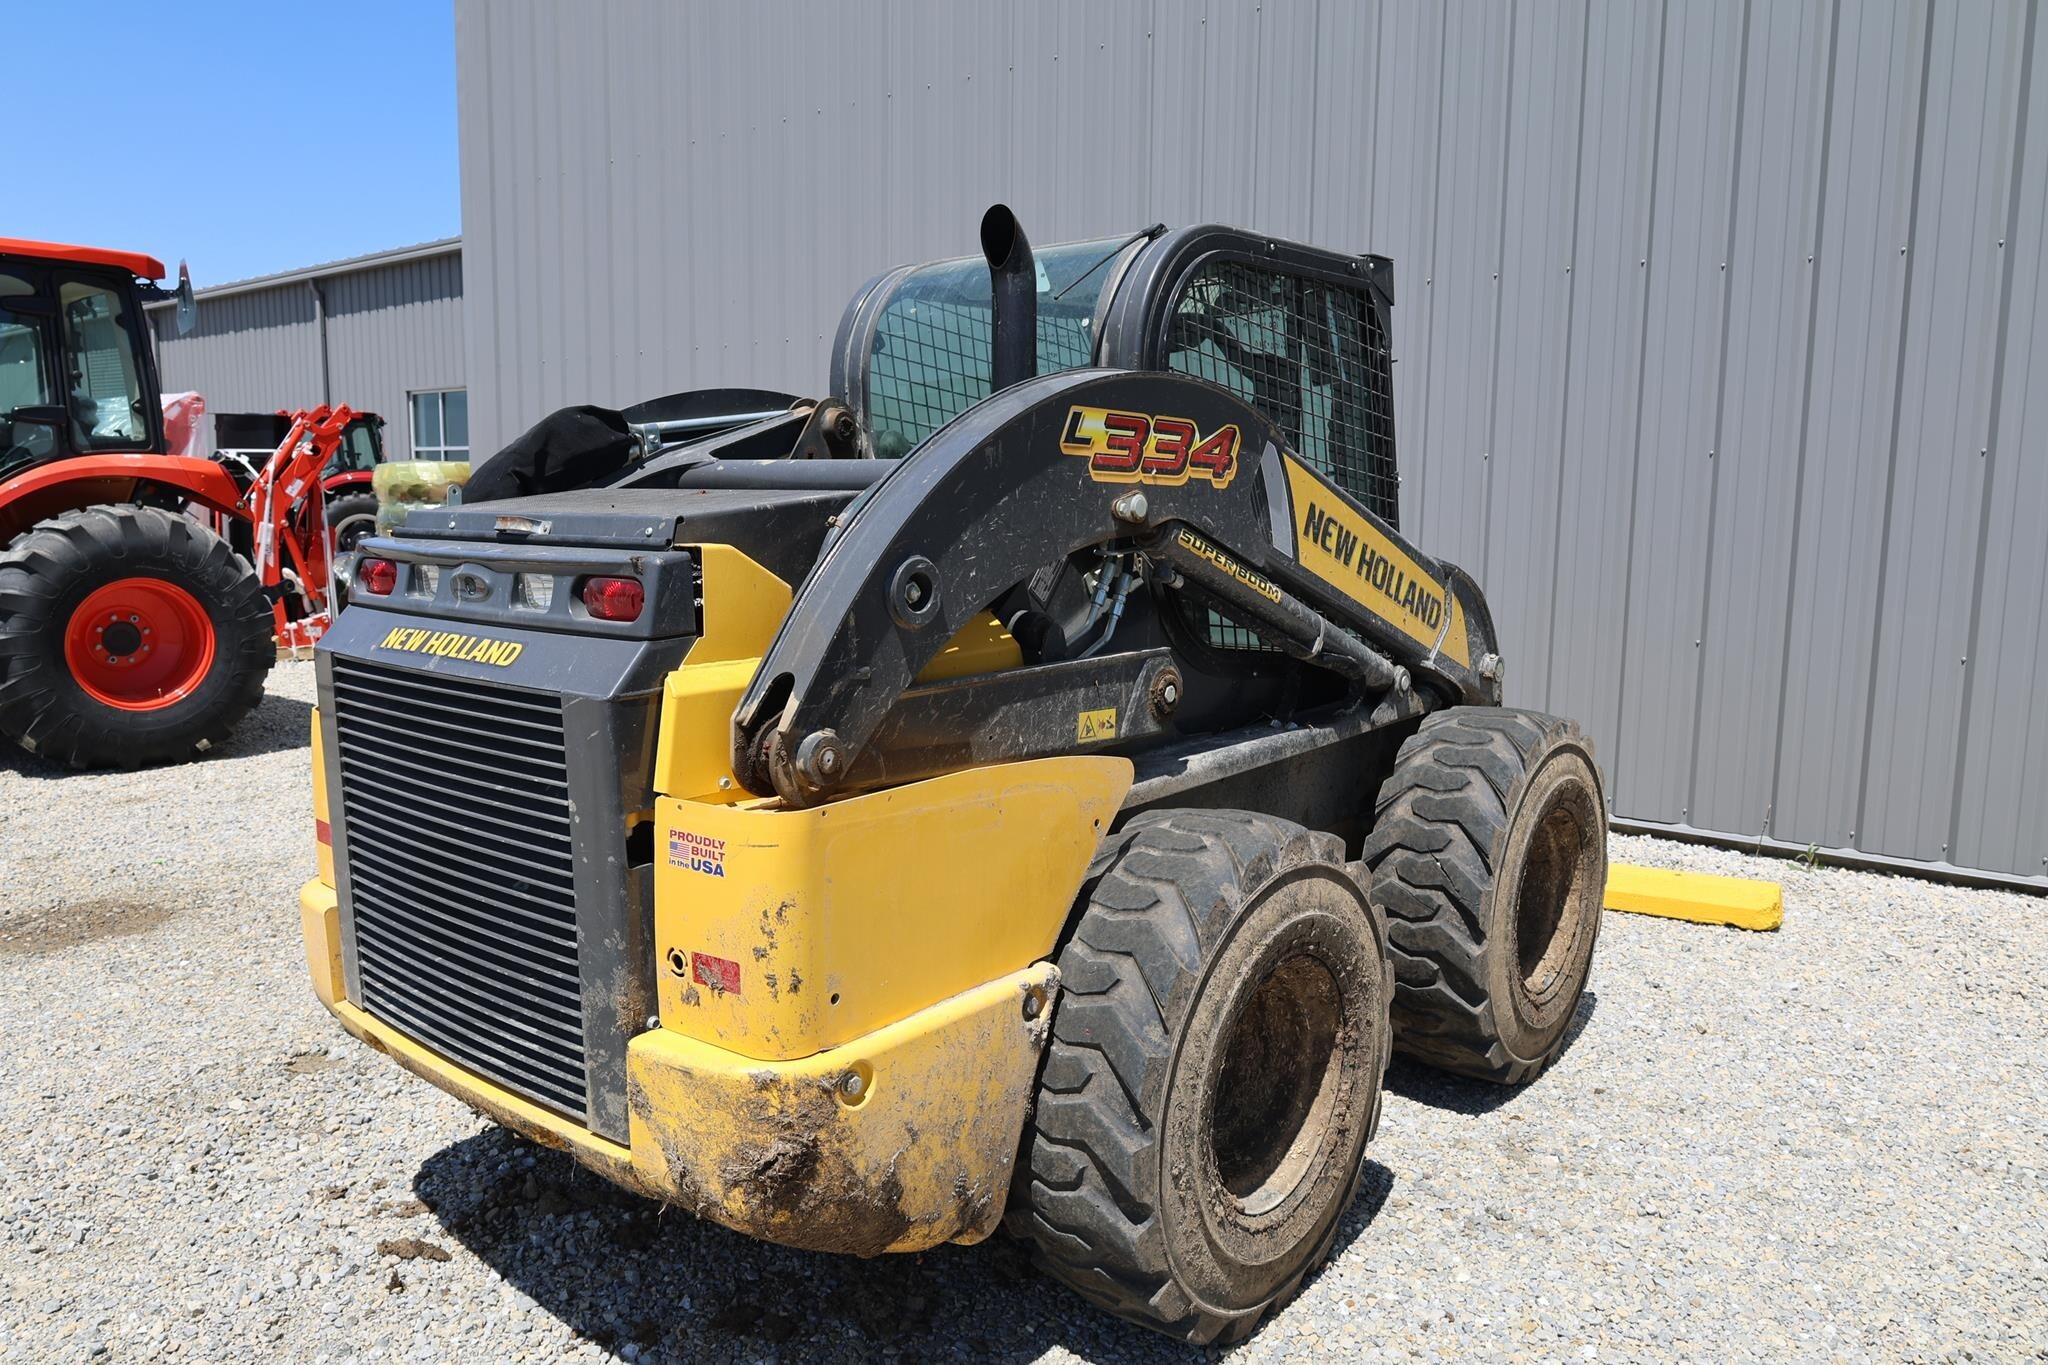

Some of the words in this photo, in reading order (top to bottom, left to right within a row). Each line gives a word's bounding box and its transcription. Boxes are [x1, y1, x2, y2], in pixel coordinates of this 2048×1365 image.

[1060, 406, 1241, 488] L334
[1303, 501, 1358, 567] NEW
[1356, 543, 1442, 630] HOLLAND
[380, 627, 432, 653] NEW
[421, 631, 523, 667] HOLLAND
[669, 829, 725, 850] PROUDLY
[691, 846, 725, 862] BUILT
[669, 857, 676, 866] in
[677, 860, 690, 869] the
[691, 857, 724, 877] USA
